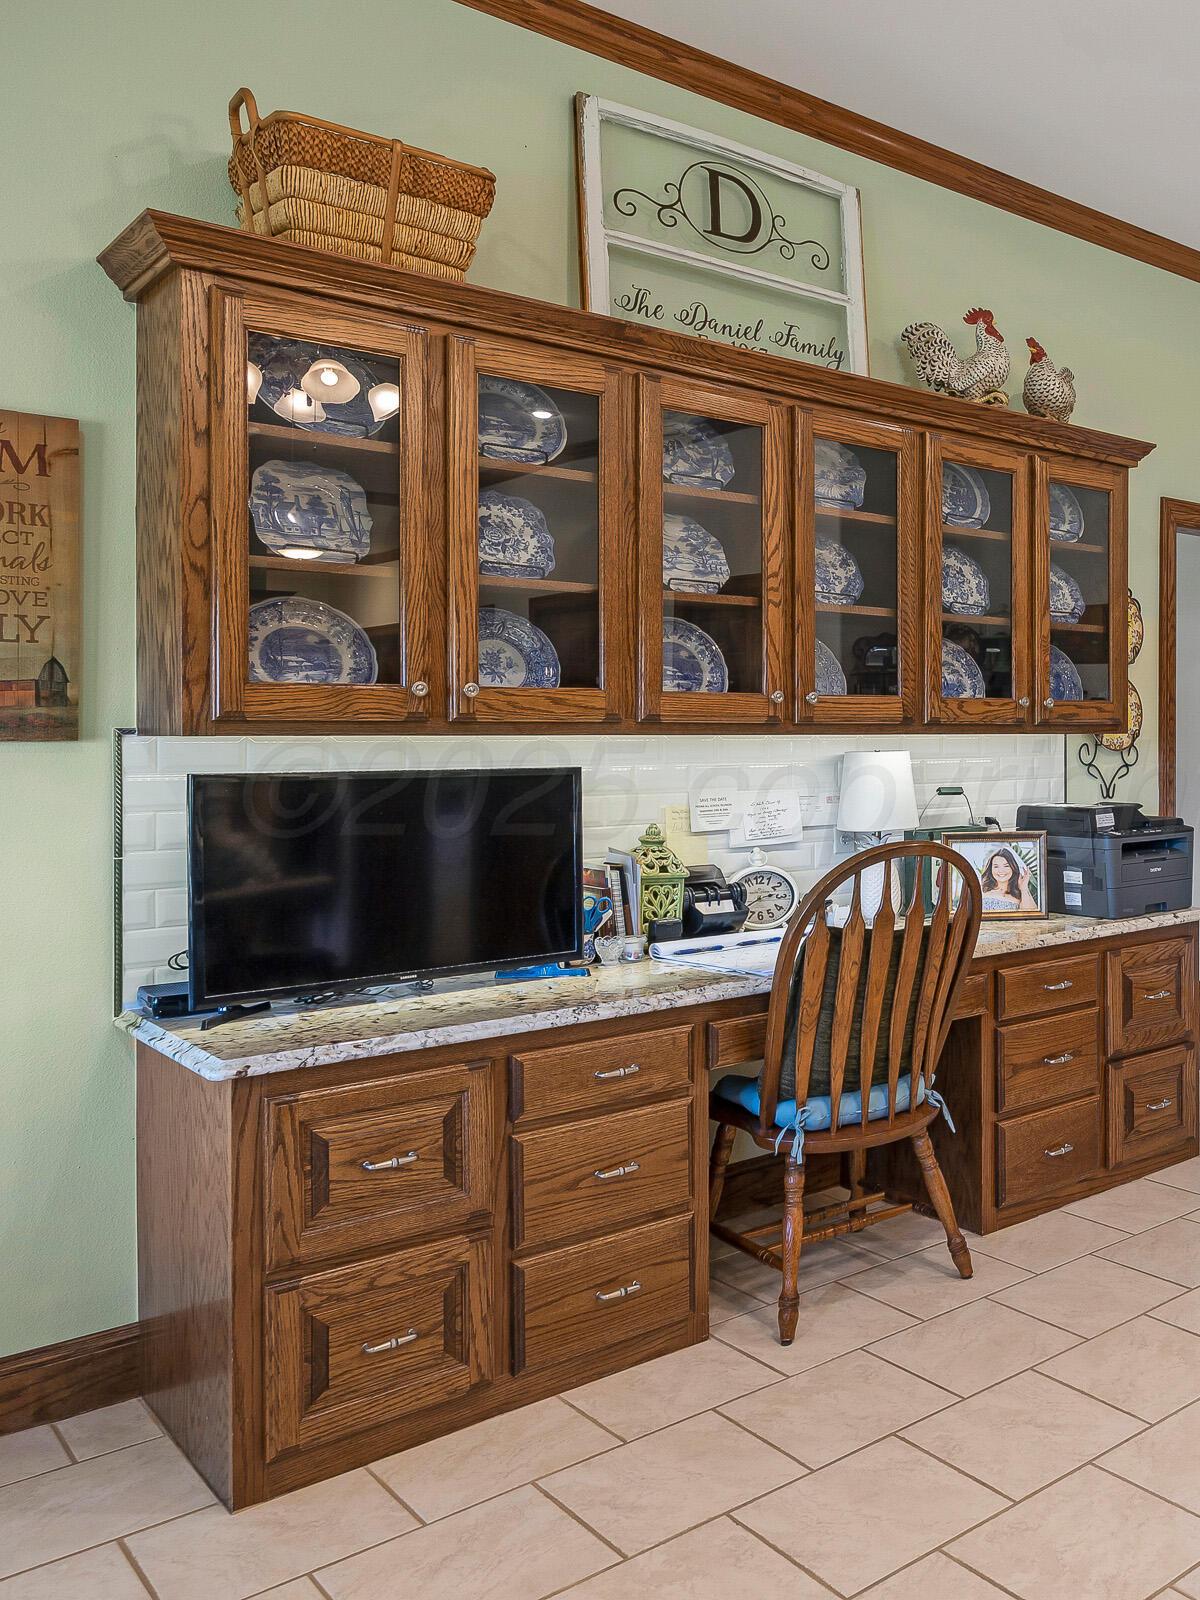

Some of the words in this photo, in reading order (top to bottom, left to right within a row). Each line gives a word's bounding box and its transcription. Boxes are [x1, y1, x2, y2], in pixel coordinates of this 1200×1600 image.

[700, 164, 762, 244] D
[613, 283, 665, 321] The
[673, 301, 764, 342] Daniel
[768, 321, 846, 371] Family
[0, 500, 50, 528] RK
